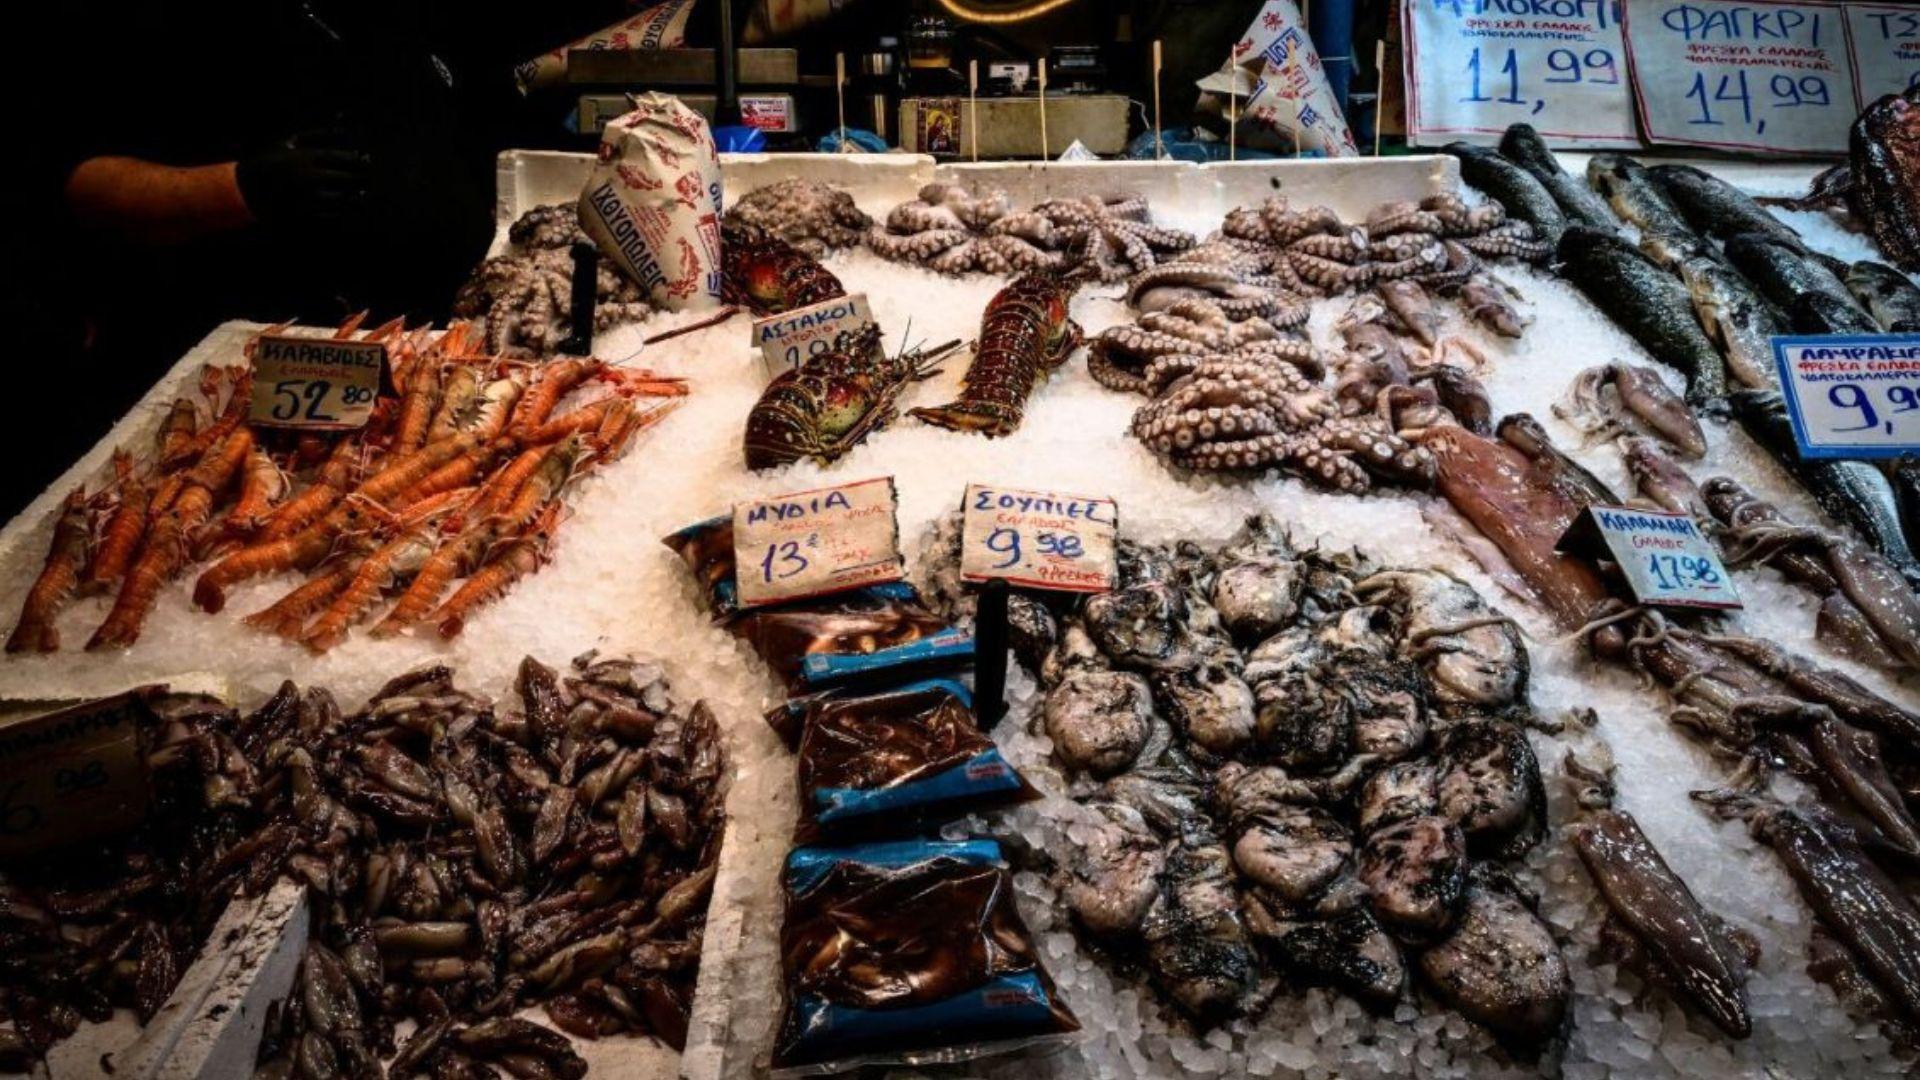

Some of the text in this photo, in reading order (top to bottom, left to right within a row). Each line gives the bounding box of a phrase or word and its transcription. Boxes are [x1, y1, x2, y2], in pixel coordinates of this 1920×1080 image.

[1662, 5, 1820, 47] ΦΑΓΚΡΙ
[1459, 47, 1619, 115] 11,99
[1685, 69, 1830, 135] 14,99
[760, 302, 857, 342] ΑΣΤΑΚΟΙ
[262, 343, 379, 368] ΚΑΡΑΒΙΔΕΣ
[748, 491, 851, 524] ΜΥΔΙΑ
[974, 490, 1112, 525] ΣΟΥΠΙΕΣ
